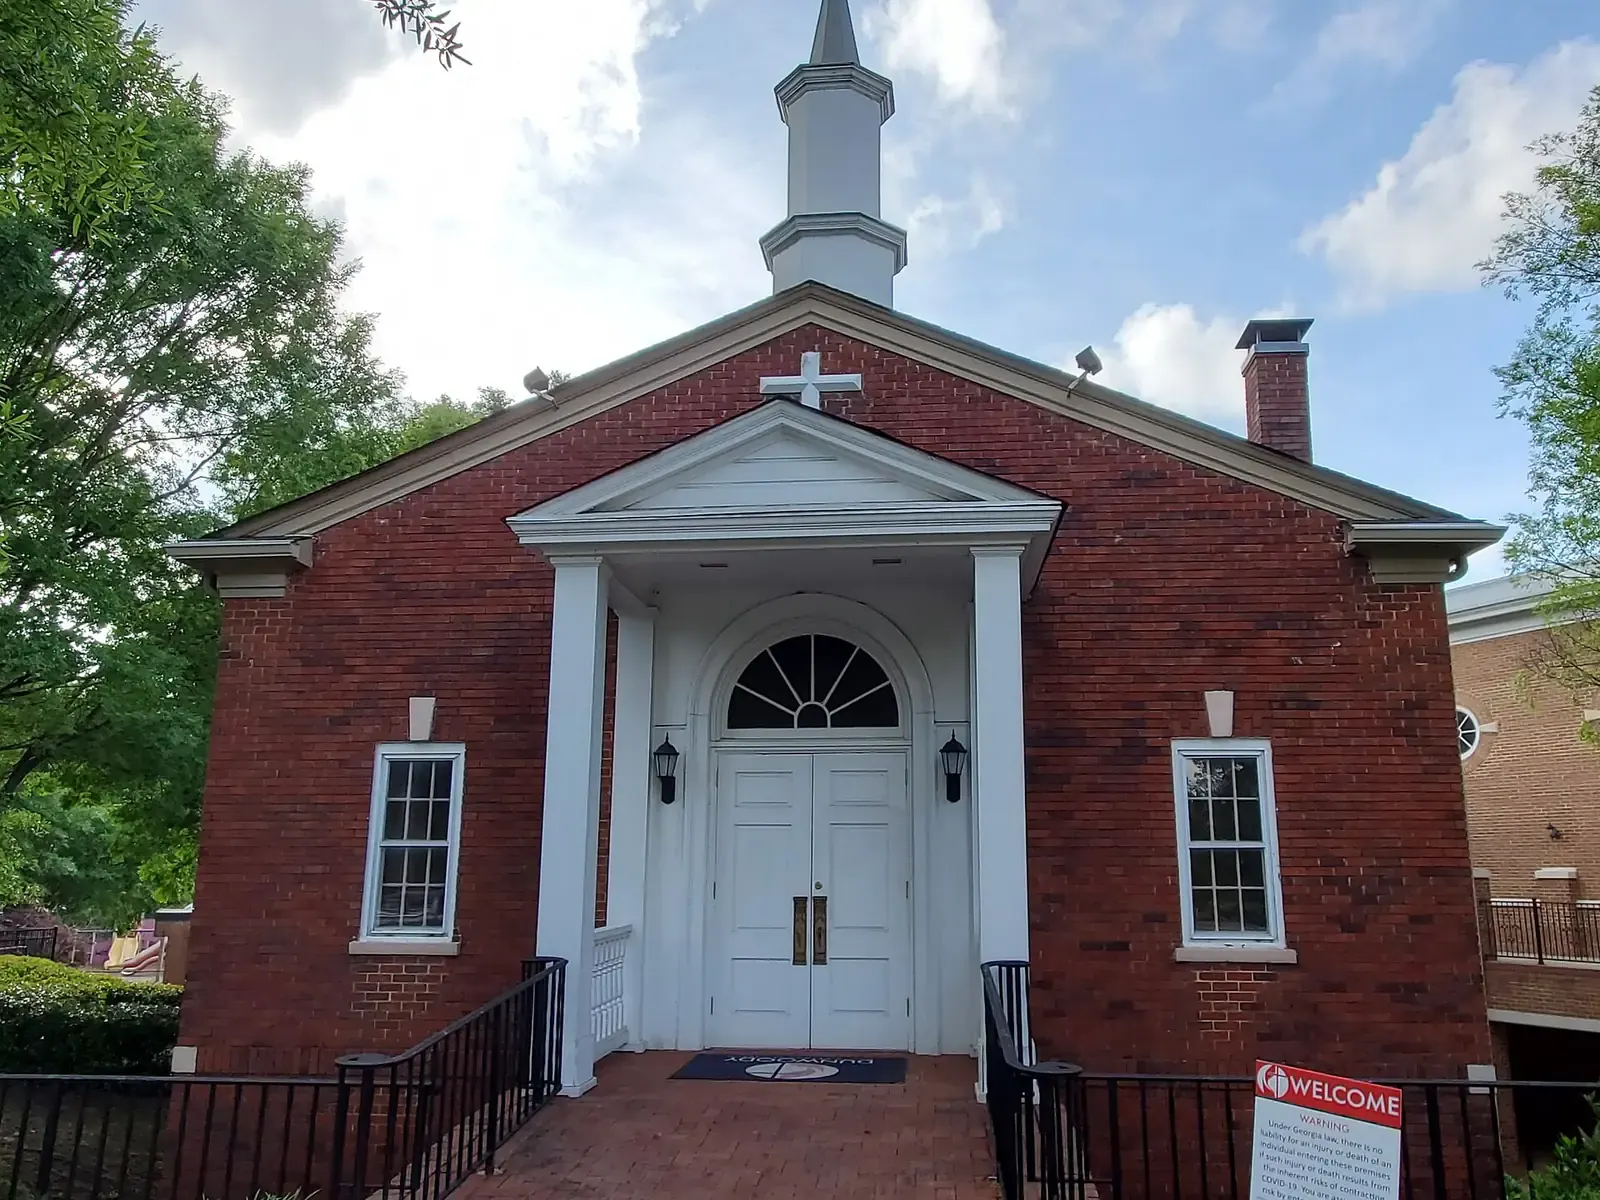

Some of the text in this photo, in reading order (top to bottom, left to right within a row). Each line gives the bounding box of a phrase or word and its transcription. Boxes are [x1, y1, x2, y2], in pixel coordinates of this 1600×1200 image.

[724, 1056, 874, 1064] DUNWOODY
[1289, 1075, 1400, 1116] WELCOME
[1268, 1119, 1383, 1155] Under Georgia law, there is no
[1300, 1113, 1350, 1133] WARNING
[1260, 1128, 1287, 1142] liability
[1288, 1135, 1298, 1145] for
[1311, 1142, 1333, 1156] injury
[1345, 1151, 1369, 1163] death
[1370, 1157, 1380, 1165] of
[1260, 1140, 1391, 1181] individual entering these premises
[1263, 1163, 1276, 1173] the
[1277, 1168, 1309, 1182] inherent
[1311, 1177, 1328, 1188] risks
[1329, 1182, 1338, 1190] of
[1266, 1153, 1283, 1163] such
[1284, 1158, 1306, 1171] injury
[1317, 1167, 1341, 1179] death
[1342, 1174, 1369, 1187] results
[1370, 1180, 1391, 1193] from
[1262, 1187, 1275, 1197] risk
[1276, 1189, 1286, 1200] by
[1301, 1186, 1315, 1197] You
[1316, 1191, 1330, 1200] are
